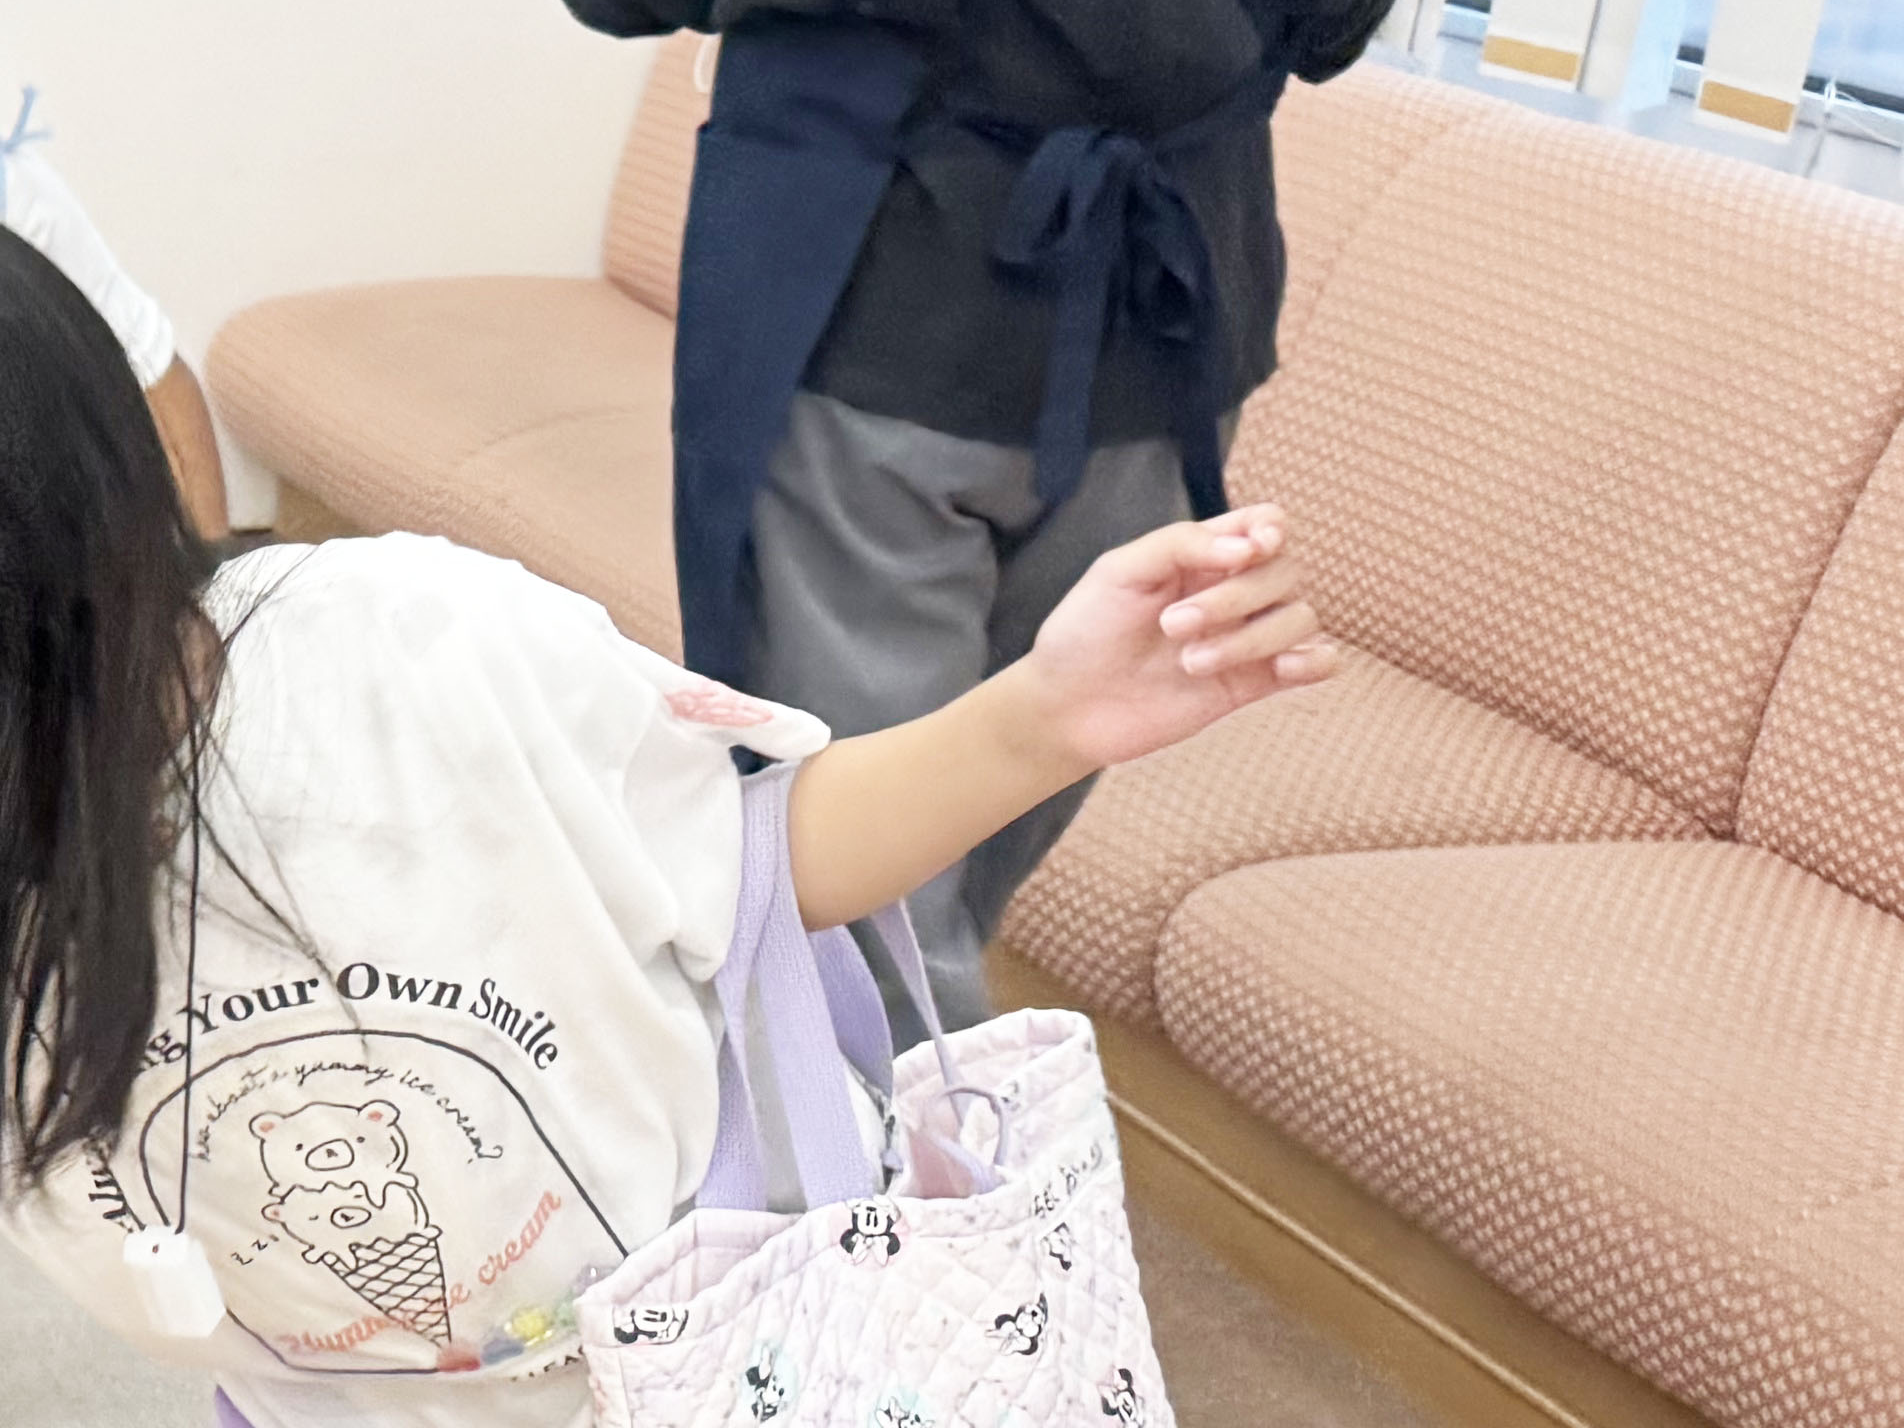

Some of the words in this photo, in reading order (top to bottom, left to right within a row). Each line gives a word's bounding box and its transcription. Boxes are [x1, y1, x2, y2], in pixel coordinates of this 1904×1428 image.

[176, 977, 320, 1035] Your
[337, 962, 464, 1010] Own
[468, 977, 558, 1071] Smile
[400, 1069, 436, 1096] ice
[478, 1190, 562, 1286] cream
